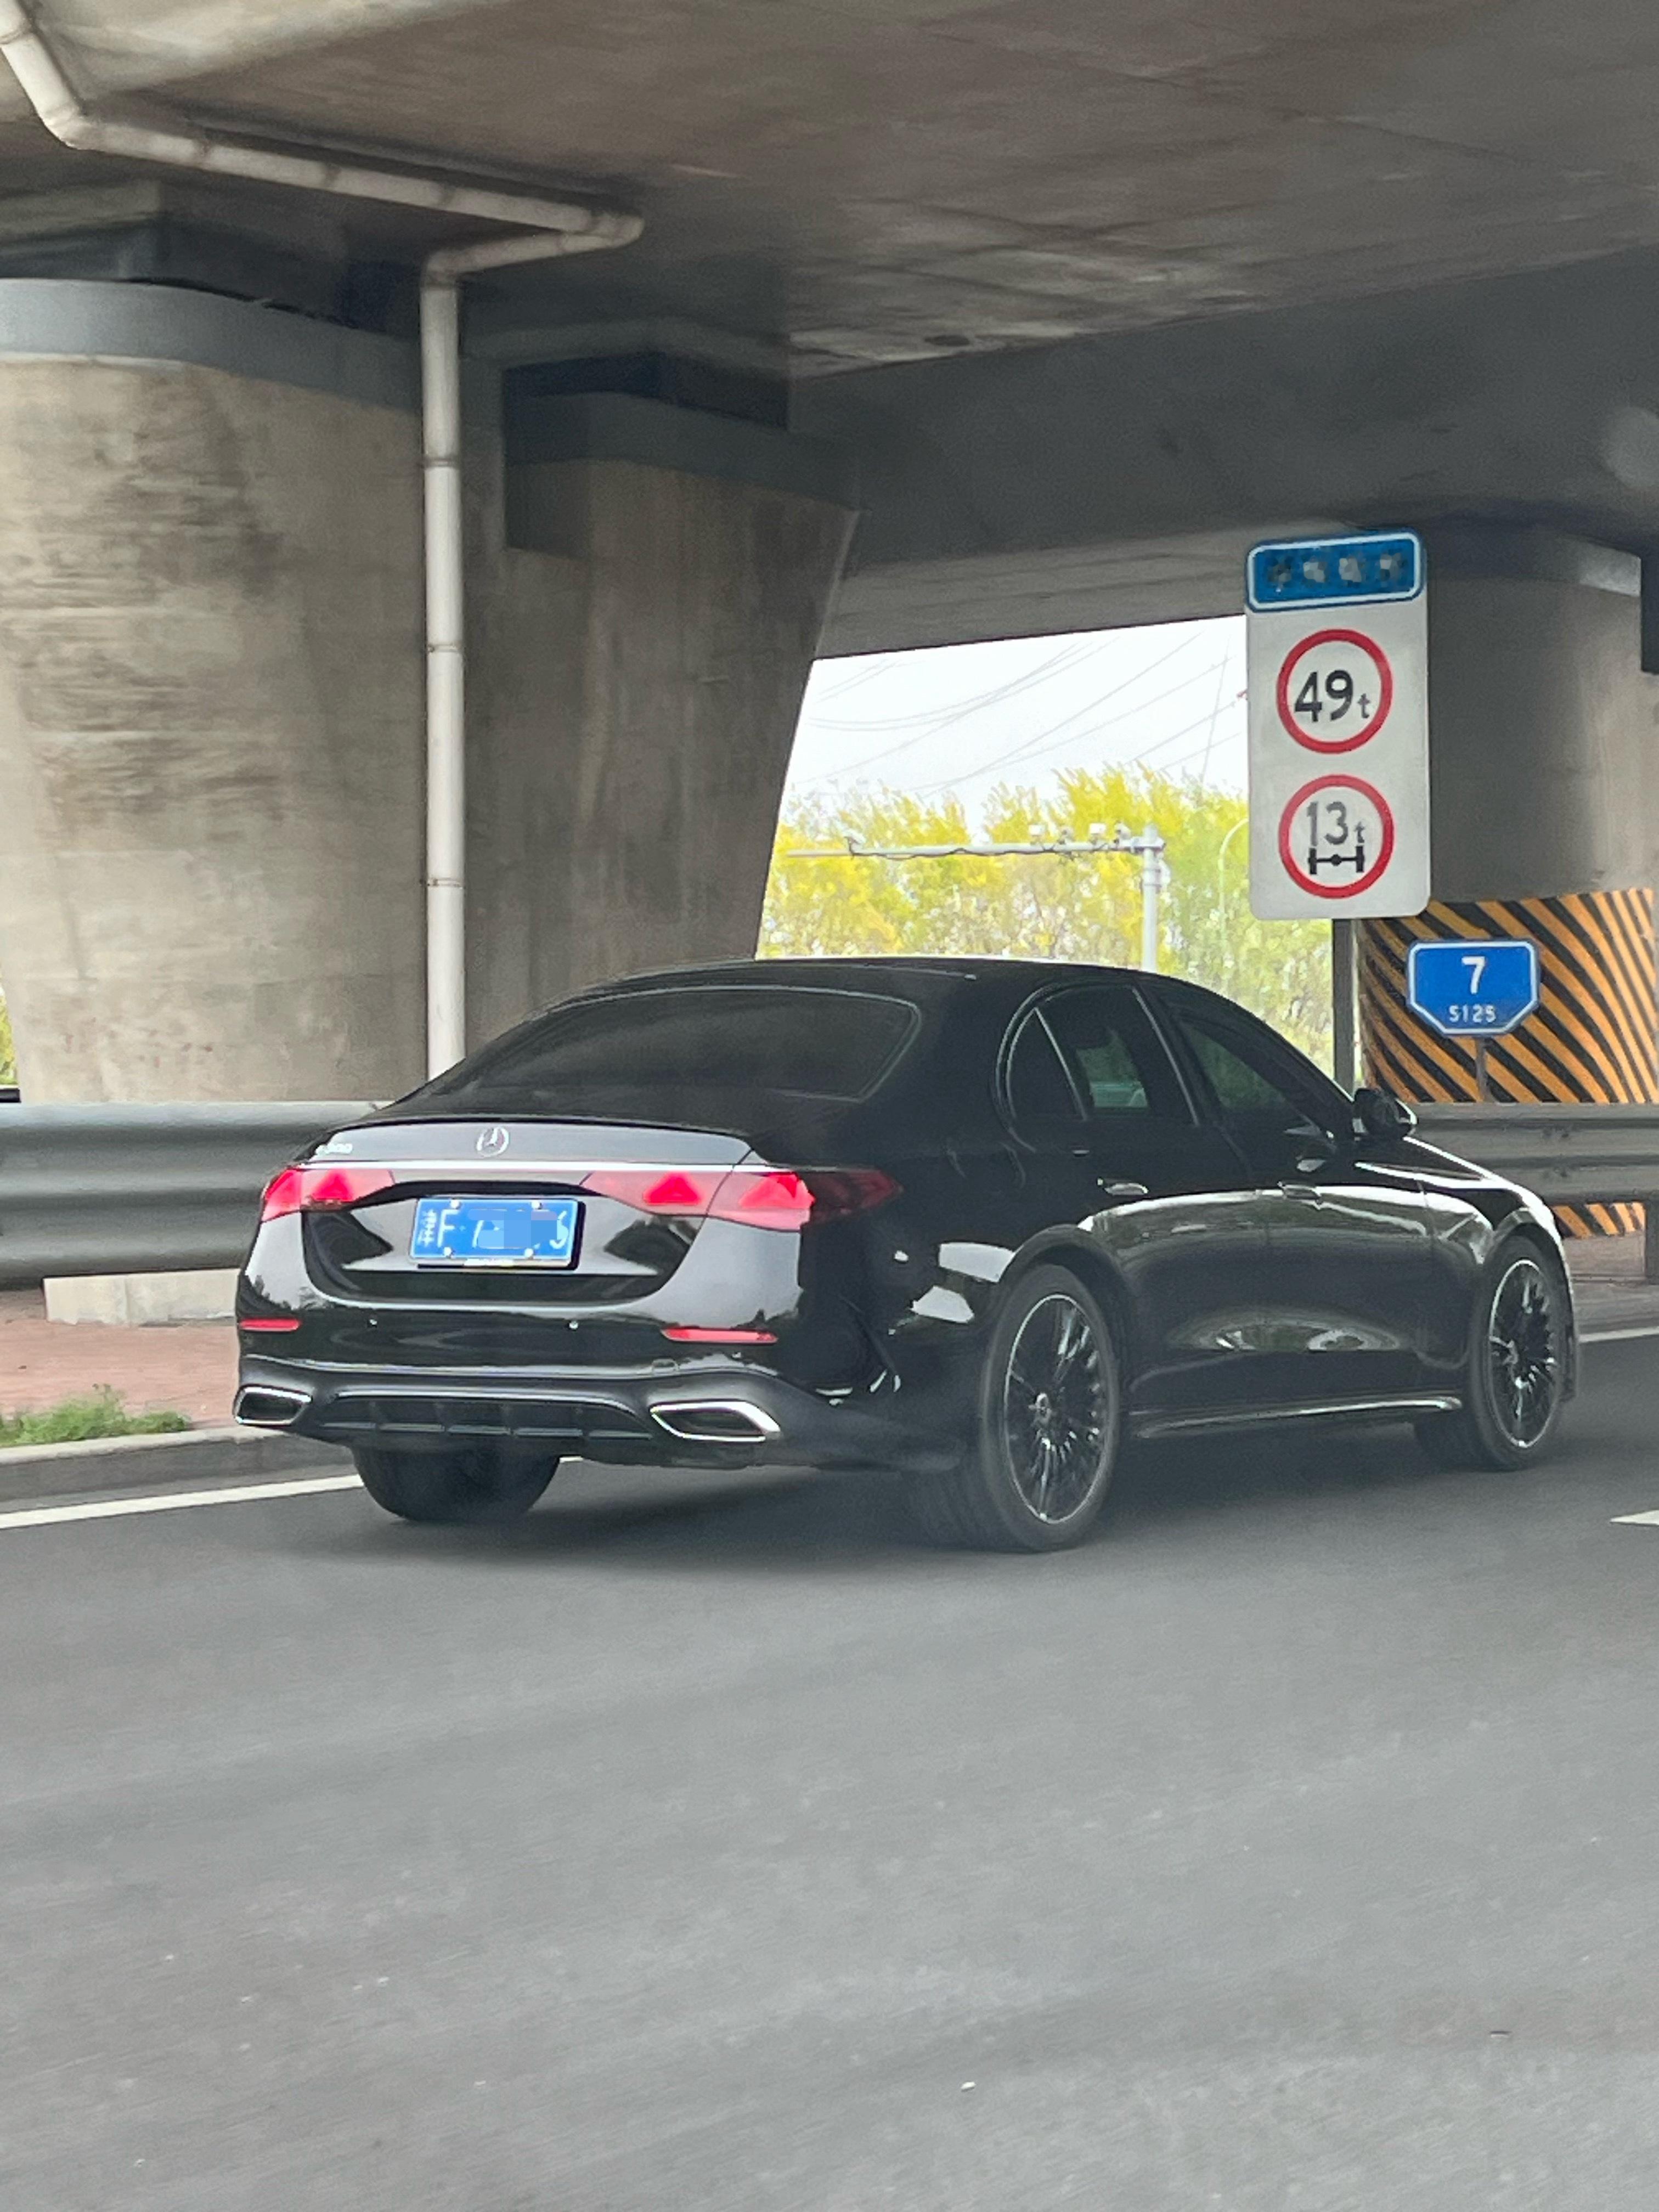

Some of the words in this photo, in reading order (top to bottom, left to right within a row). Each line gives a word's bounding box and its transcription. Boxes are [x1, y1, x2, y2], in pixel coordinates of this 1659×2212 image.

[1294, 669, 1370, 723] 49t
[1306, 800, 1365, 847] 13t
[1461, 956, 1486, 995] 7
[1448, 1003, 1497, 1023] S125
